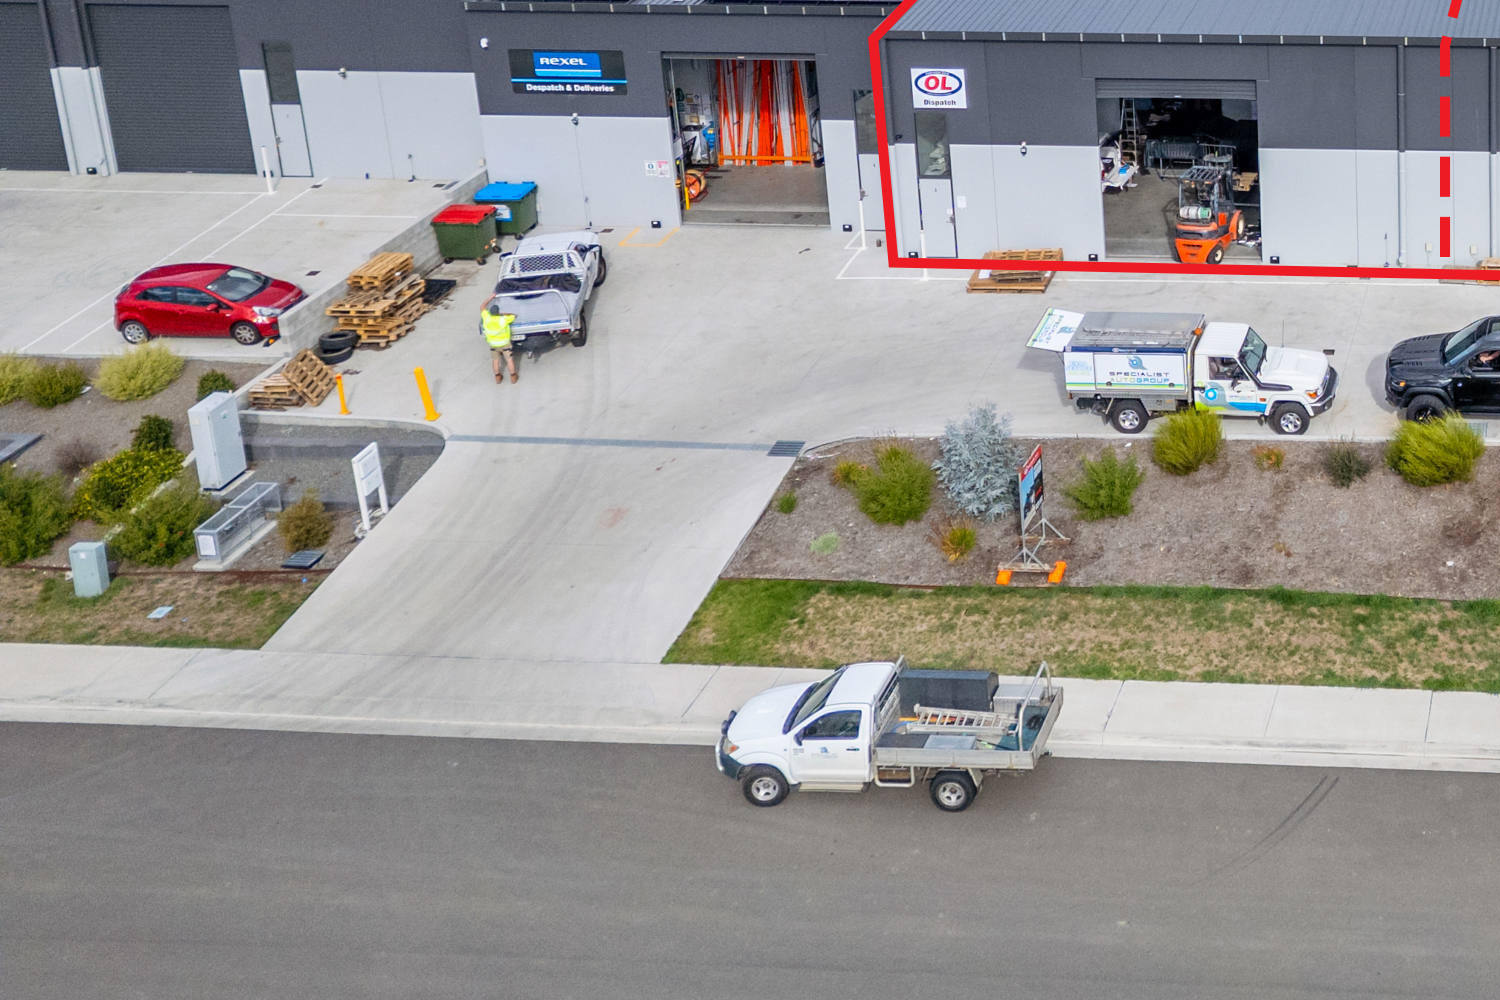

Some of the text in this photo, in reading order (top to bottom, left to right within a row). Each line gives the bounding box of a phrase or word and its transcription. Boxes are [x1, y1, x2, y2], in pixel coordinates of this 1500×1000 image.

[526, 83, 616, 93] Despatch & Deliveries
[924, 75, 953, 91] OL
[923, 99, 957, 107] Dispatch
